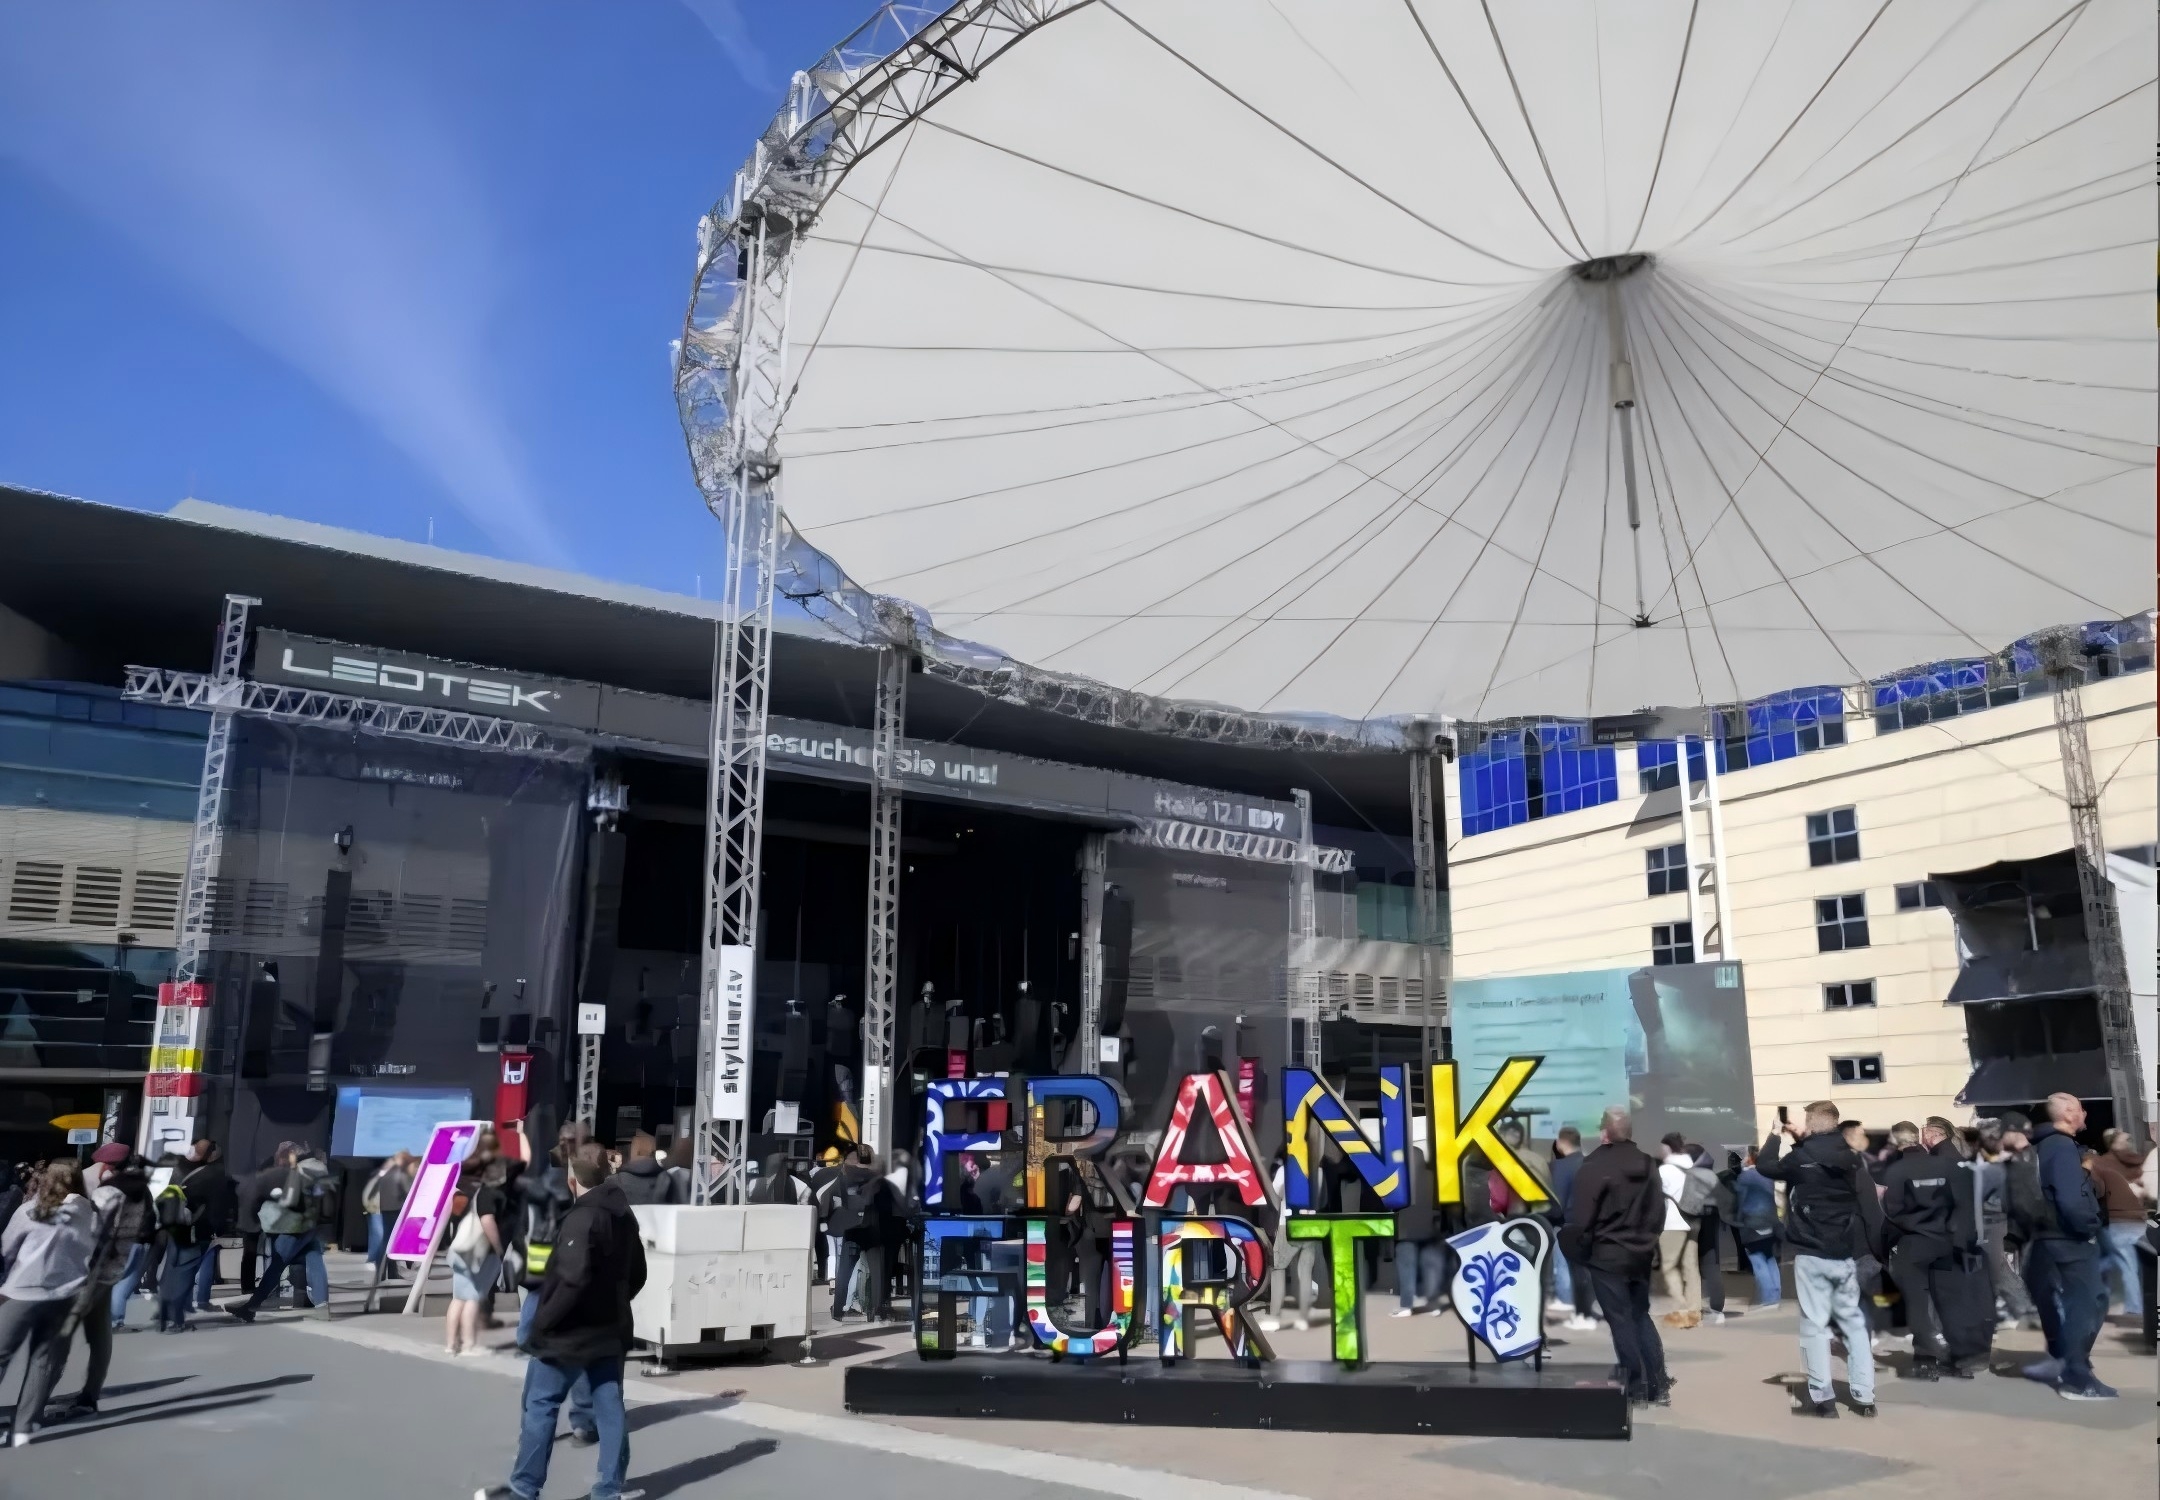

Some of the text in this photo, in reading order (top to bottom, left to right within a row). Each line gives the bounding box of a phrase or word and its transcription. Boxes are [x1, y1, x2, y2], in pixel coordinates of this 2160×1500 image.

[282, 648, 552, 713] LEDTEK
[755, 733, 884, 772] esuch
[922, 1056, 1556, 1210] FRANK
[918, 1213, 1397, 1365] FURT
